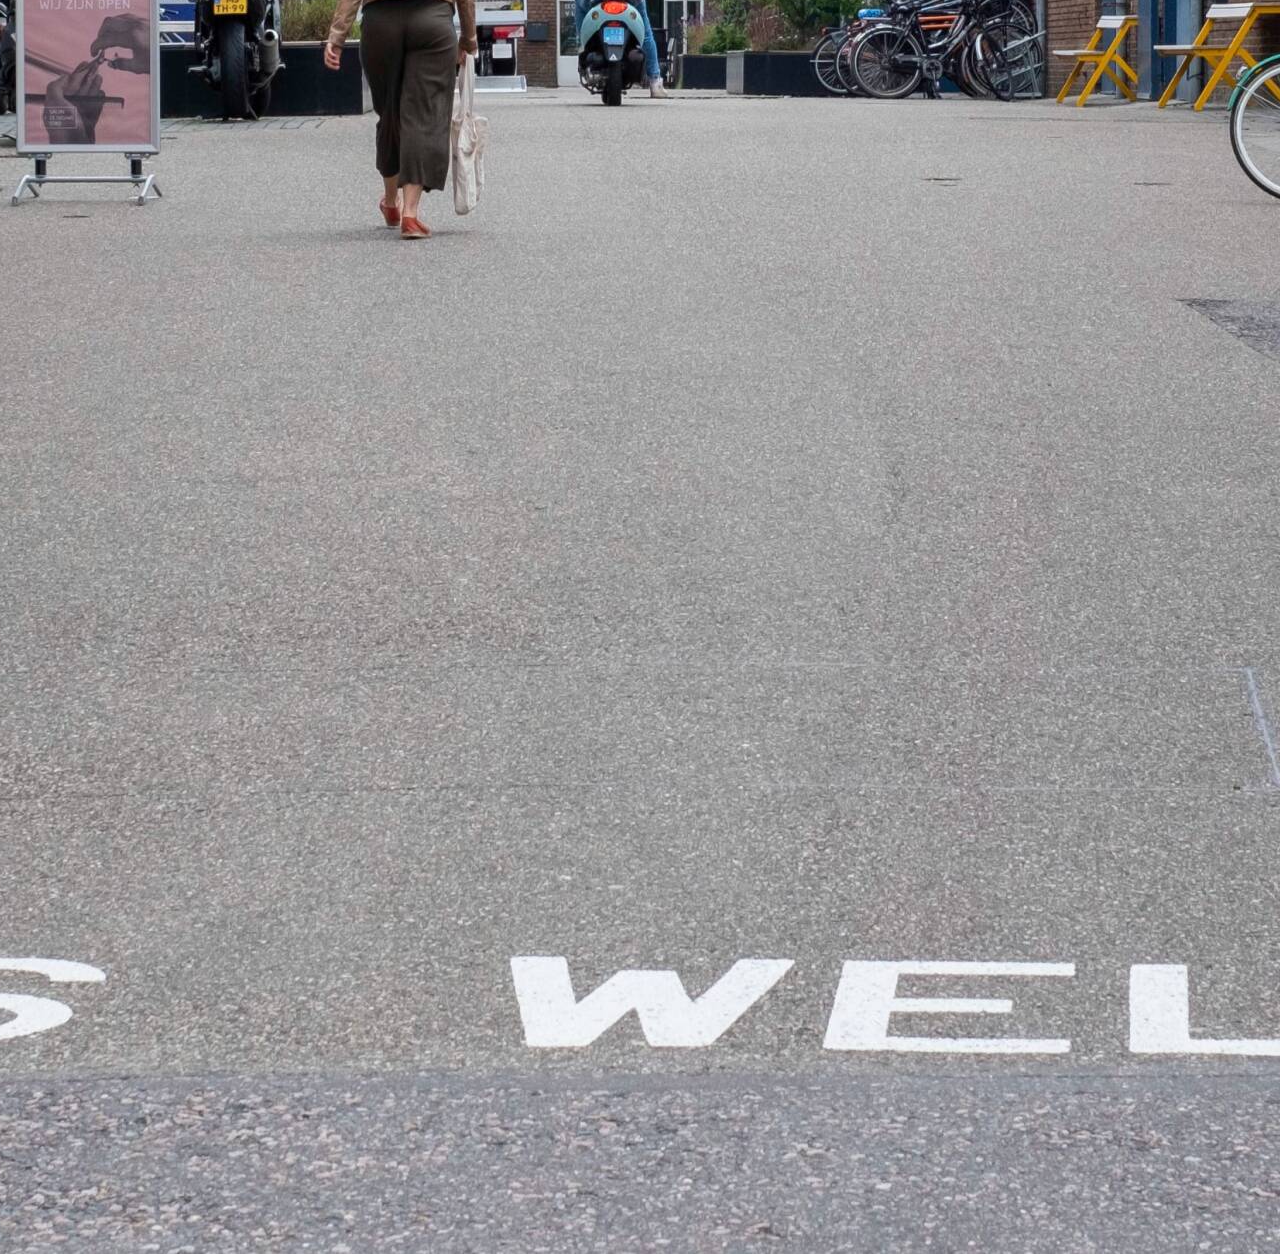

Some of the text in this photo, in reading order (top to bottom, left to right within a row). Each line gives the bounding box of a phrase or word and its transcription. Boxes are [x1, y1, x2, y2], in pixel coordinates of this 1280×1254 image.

[39, 0, 61, 10] WIJ
[66, 0, 94, 10] ZIJN
[216, 4, 245, 12] TH-99
